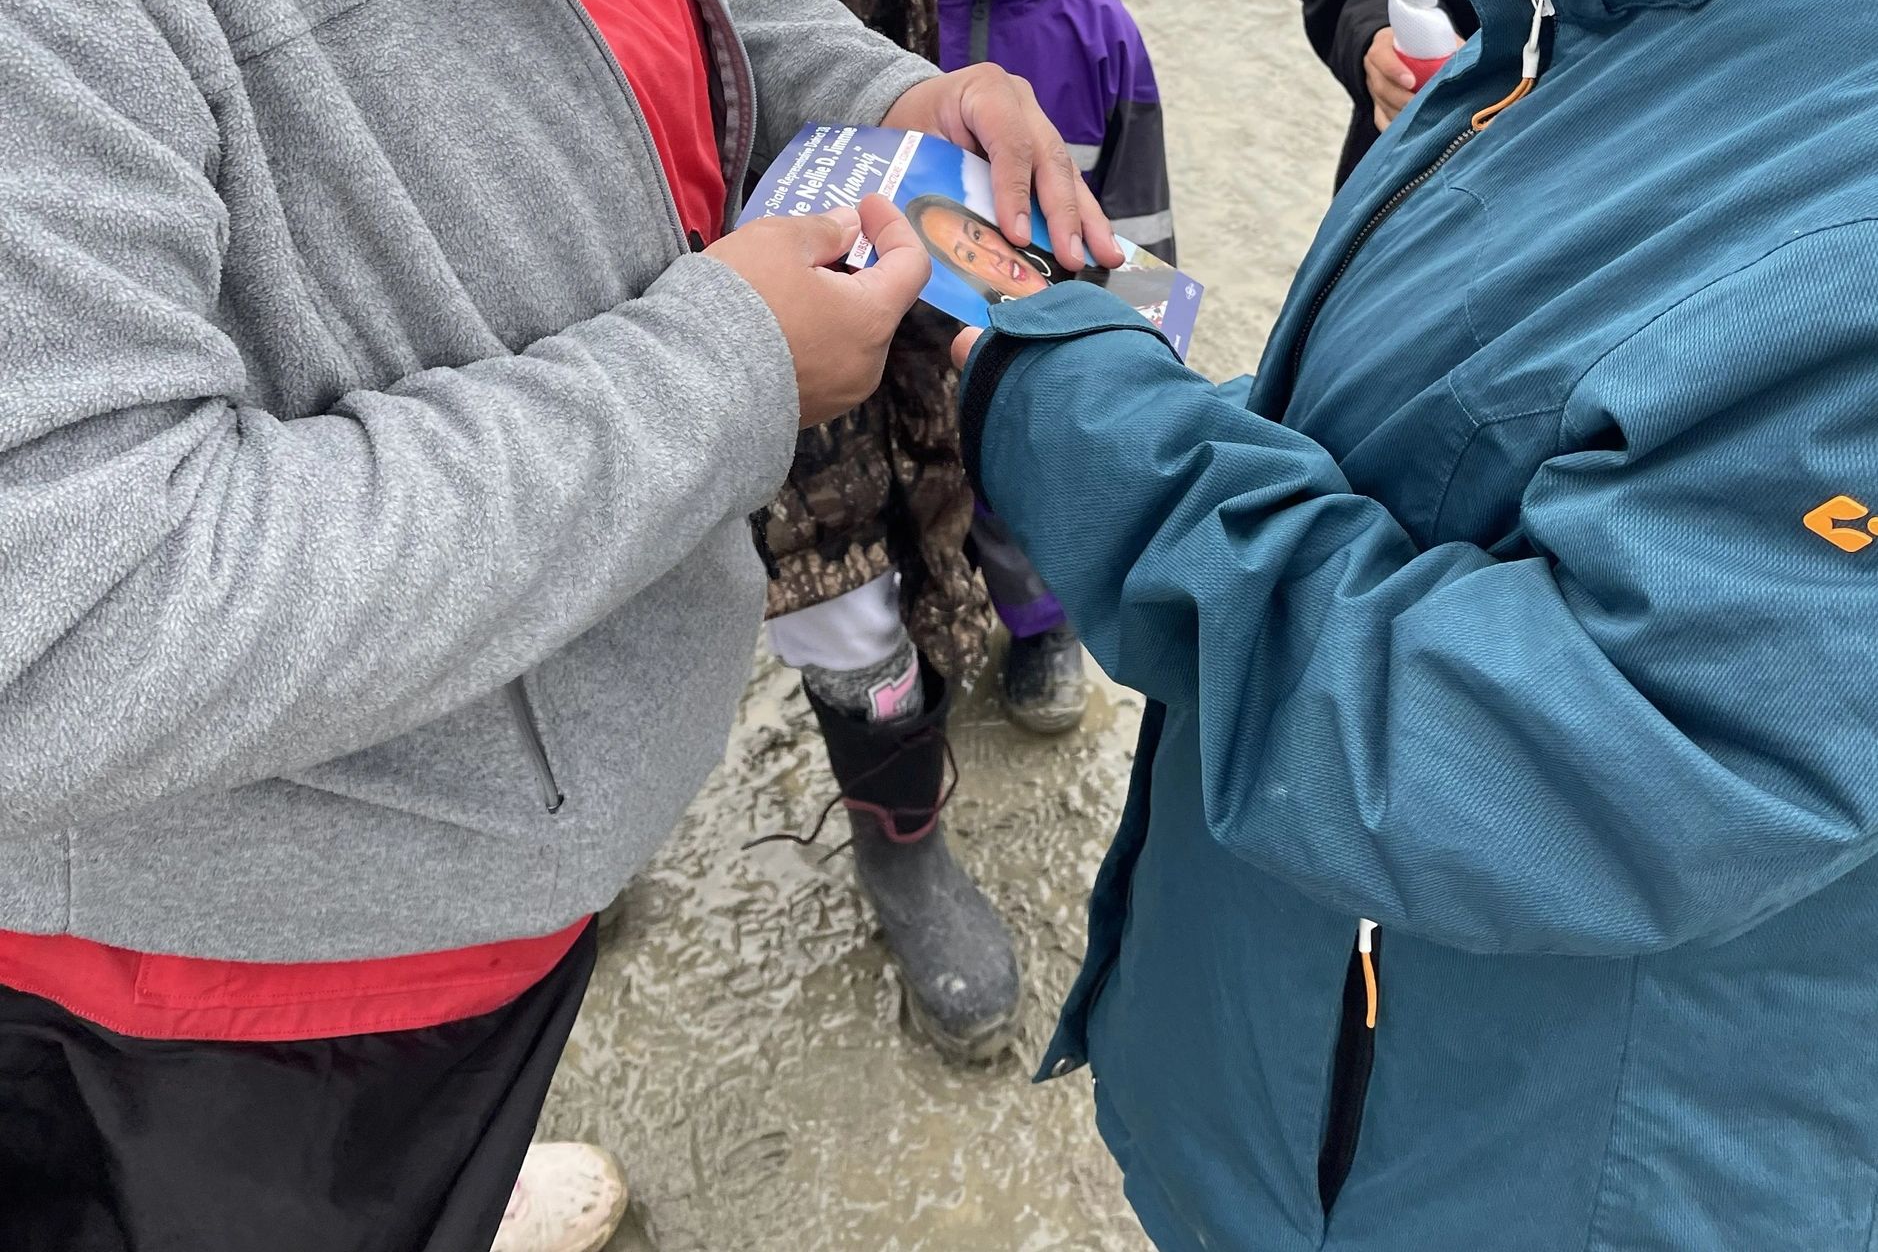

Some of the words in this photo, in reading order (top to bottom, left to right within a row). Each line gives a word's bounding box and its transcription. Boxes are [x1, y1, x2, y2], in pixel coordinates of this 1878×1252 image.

[823, 127, 857, 155] Jimmie
[765, 186, 788, 209] State
[777, 147, 815, 185] Representative
[804, 132, 825, 147] District
[815, 156, 839, 167] D.
[795, 166, 831, 200] Nellie
